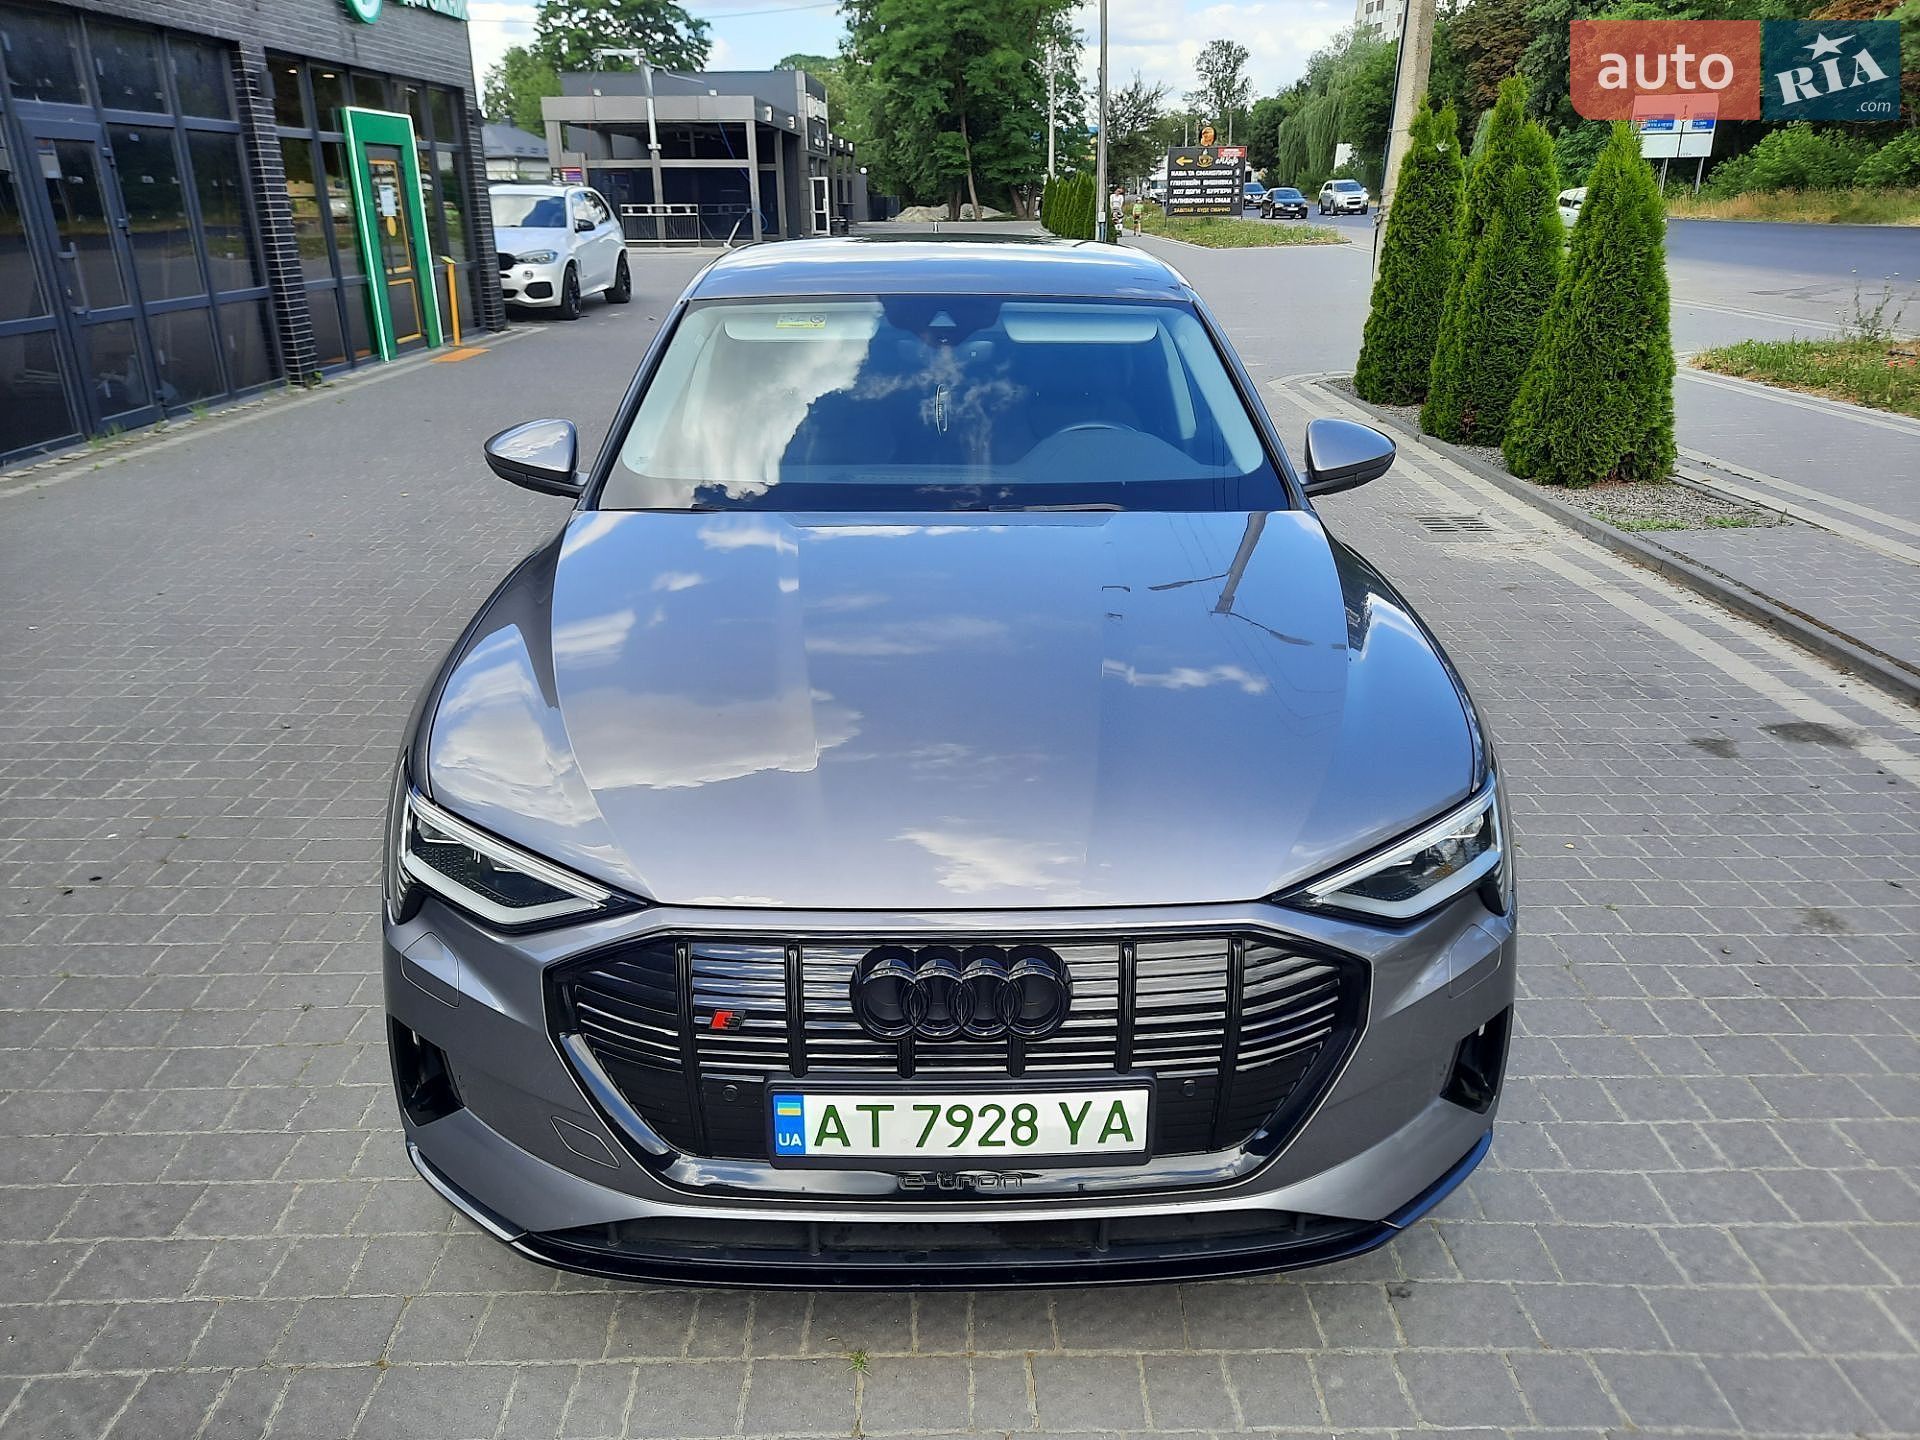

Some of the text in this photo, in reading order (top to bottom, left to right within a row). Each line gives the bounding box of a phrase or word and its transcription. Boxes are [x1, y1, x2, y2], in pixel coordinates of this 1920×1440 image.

[814, 1100, 1135, 1148] AT 7928 YA
[778, 1133, 802, 1146] UA
[898, 1172, 1022, 1190] e-tron
